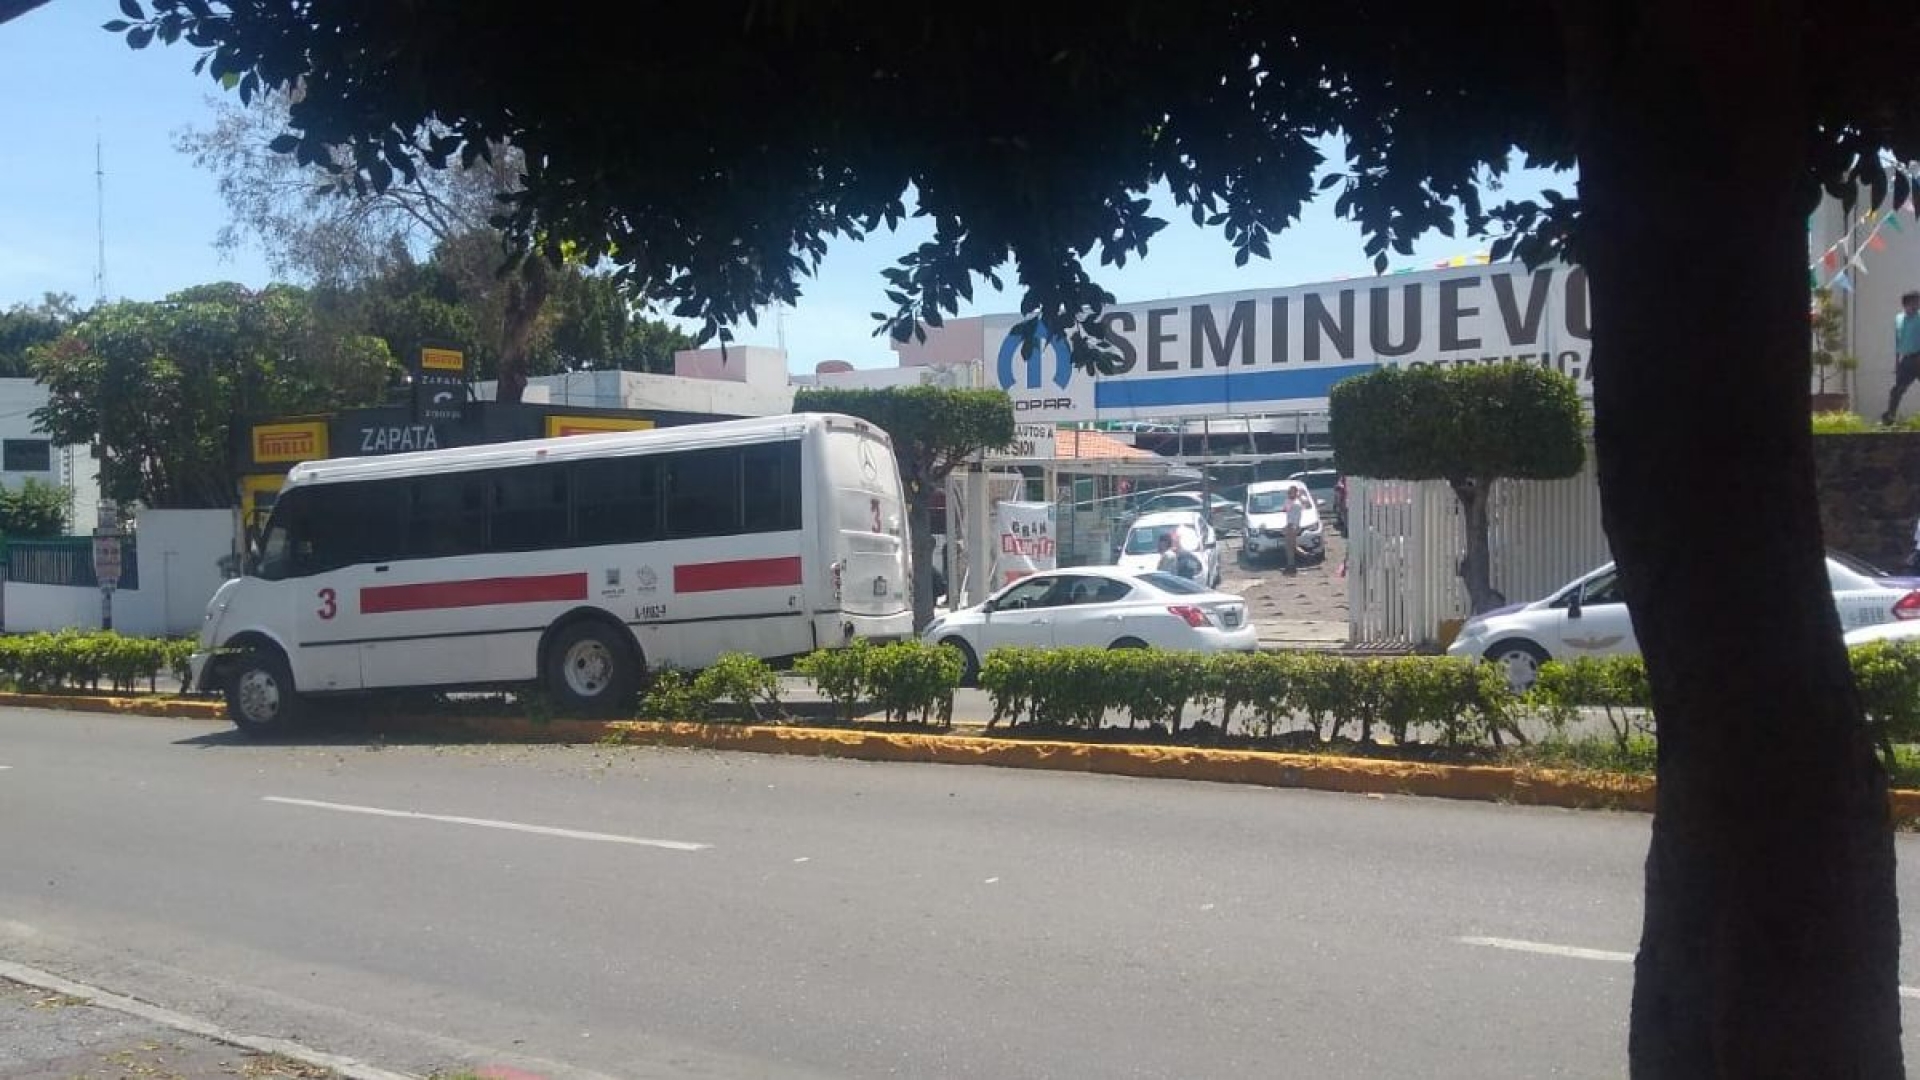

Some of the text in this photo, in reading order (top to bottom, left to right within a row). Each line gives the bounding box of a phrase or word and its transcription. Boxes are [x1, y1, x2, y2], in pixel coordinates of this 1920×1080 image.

[1015, 397, 1072, 411] OPAR
[259, 431, 315, 456] PIRELLI
[360, 424, 438, 451] ZAPATA
[871, 499, 882, 533] 3
[1012, 520, 1047, 537] GRAN
[317, 588, 337, 620] 3
